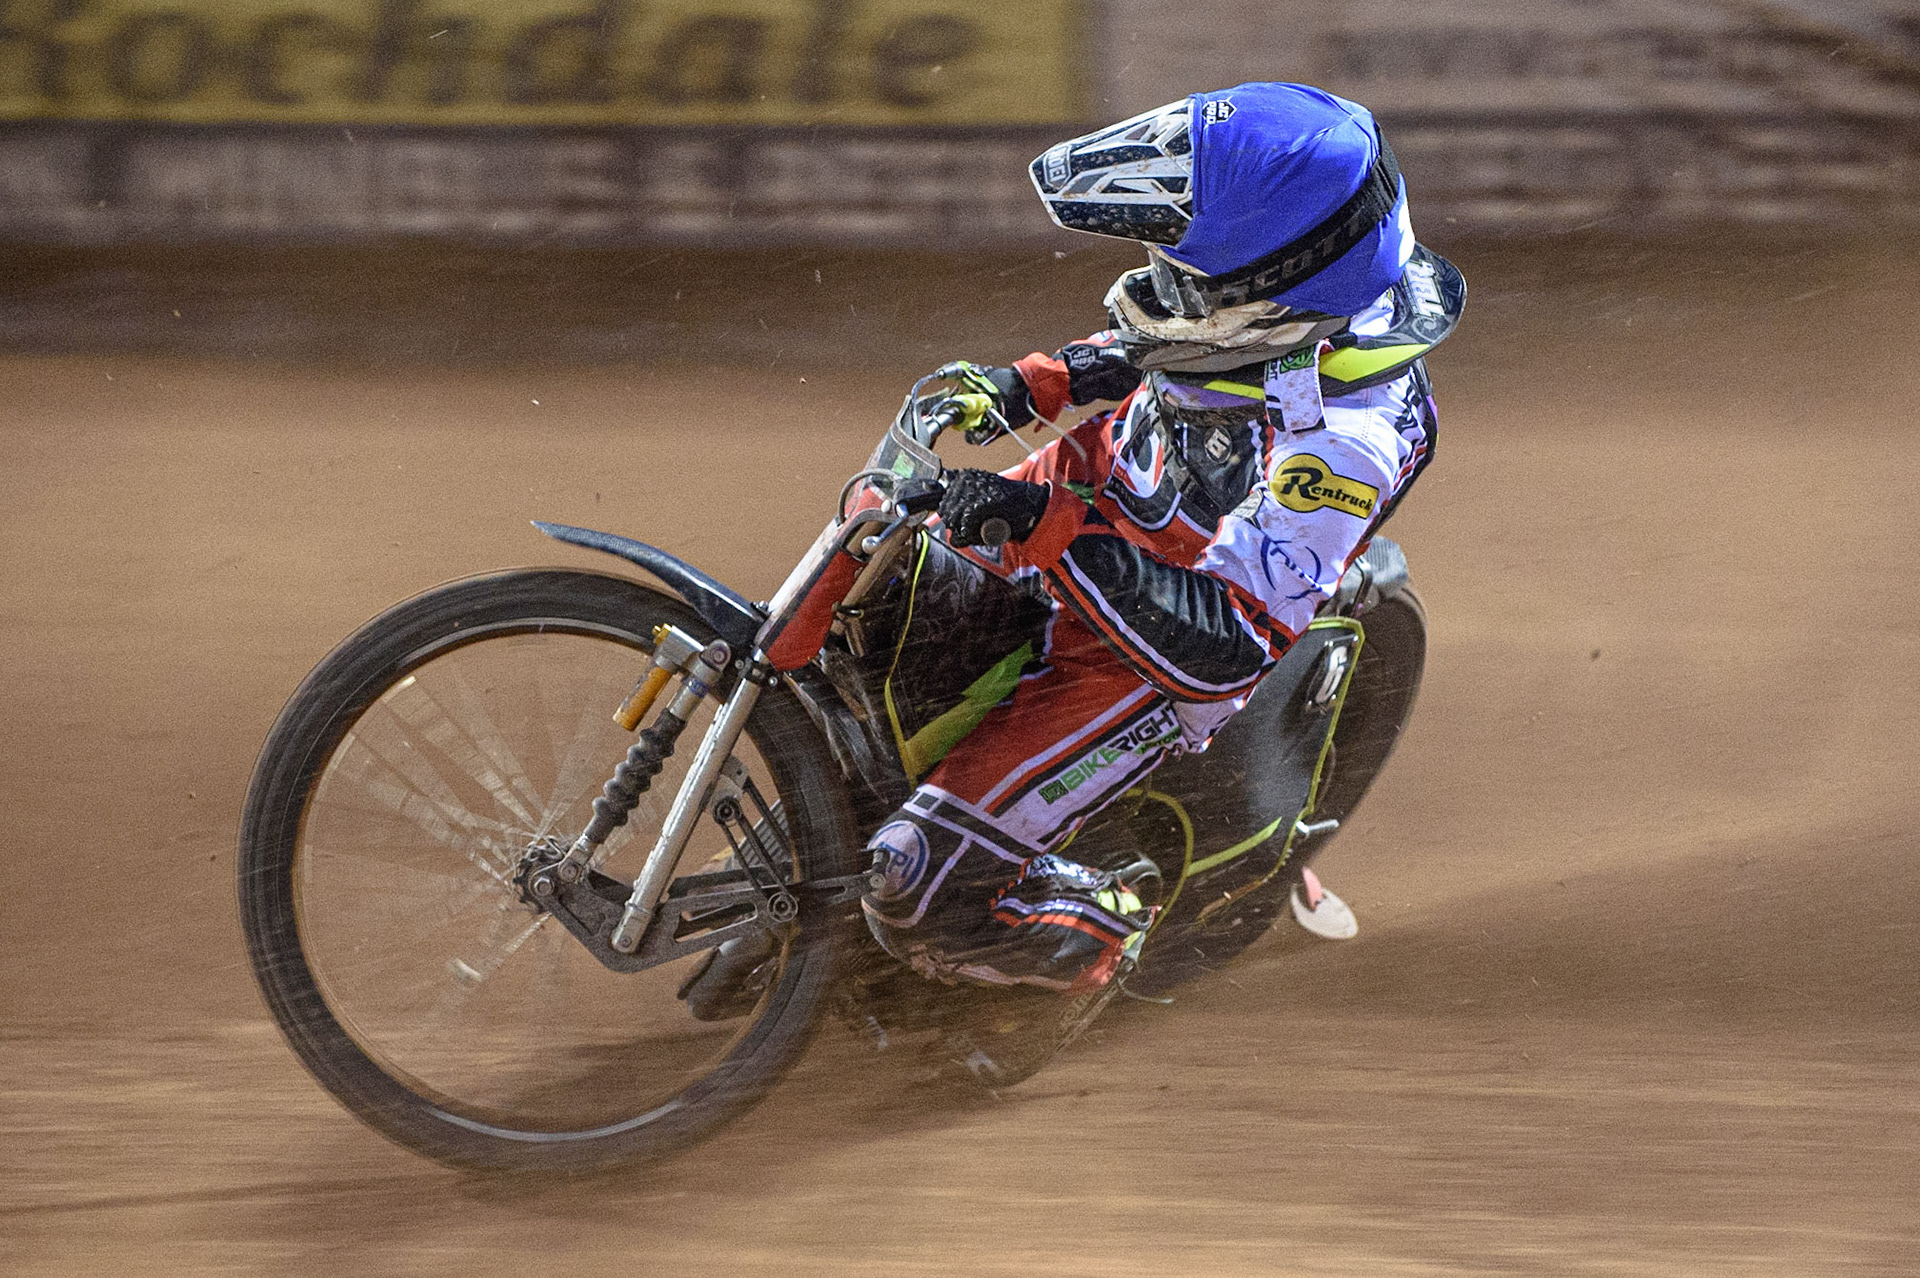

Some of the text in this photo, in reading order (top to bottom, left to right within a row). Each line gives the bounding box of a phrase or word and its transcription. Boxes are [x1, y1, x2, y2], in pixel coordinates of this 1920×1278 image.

[1205, 100, 1217, 124] PRO
[1070, 356, 1096, 366] PRO
[1073, 349, 1091, 359] JC
[1281, 466, 1374, 512] Rentruck
[1060, 704, 1175, 790] BIKERIGH
